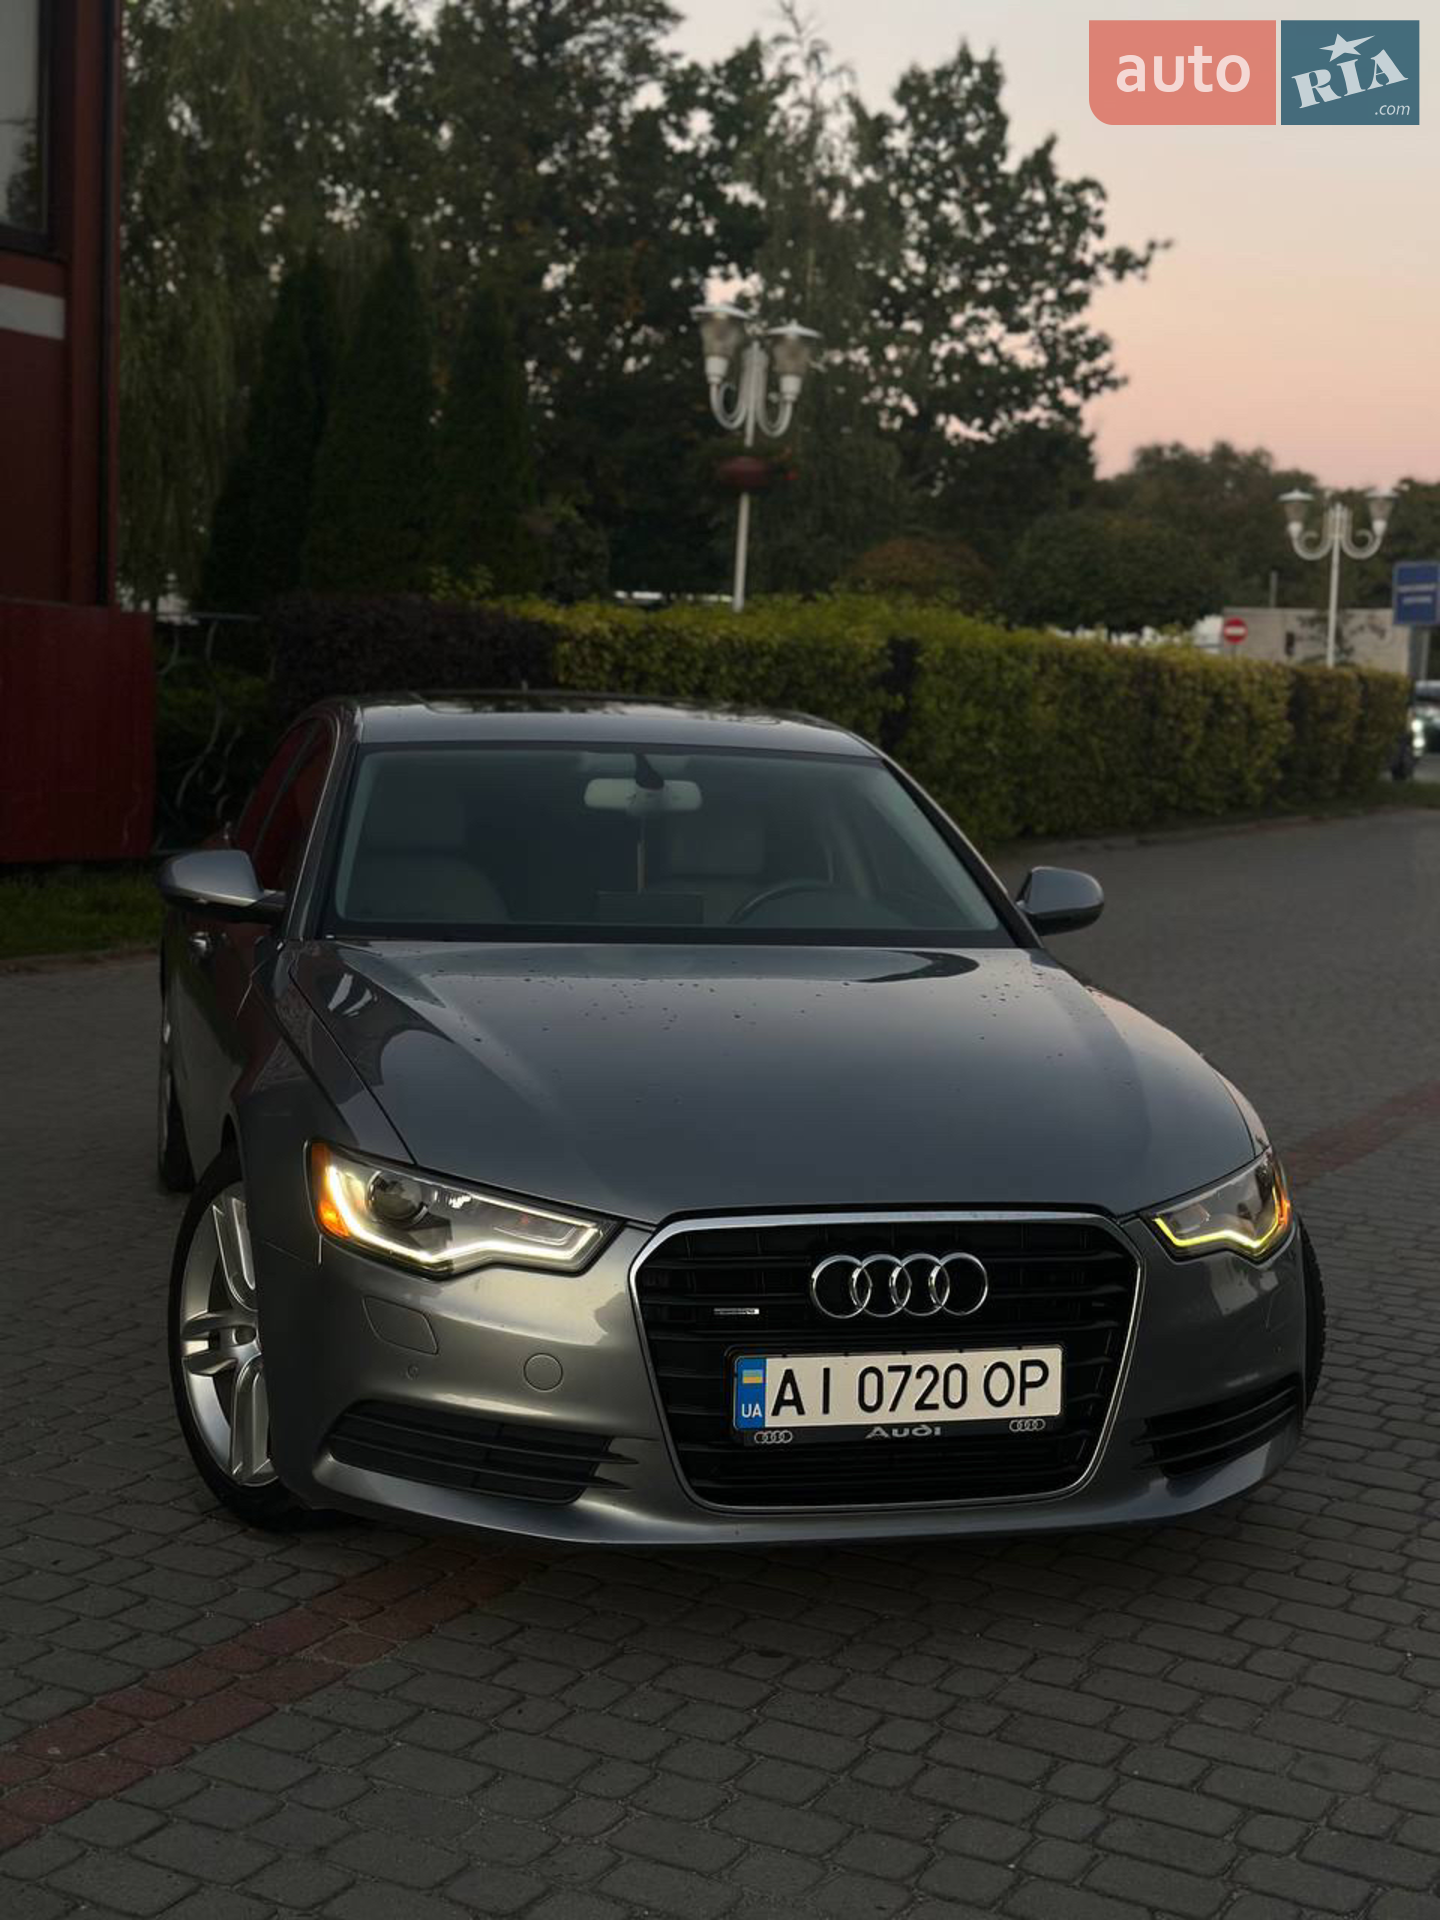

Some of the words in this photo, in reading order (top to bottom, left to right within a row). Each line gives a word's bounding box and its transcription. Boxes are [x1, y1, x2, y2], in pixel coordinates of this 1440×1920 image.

[771, 1367, 830, 1416] AI
[858, 1363, 967, 1413] 0720
[983, 1359, 1049, 1408] OP
[741, 1403, 763, 1418] UA
[865, 1424, 942, 1440] Audi
